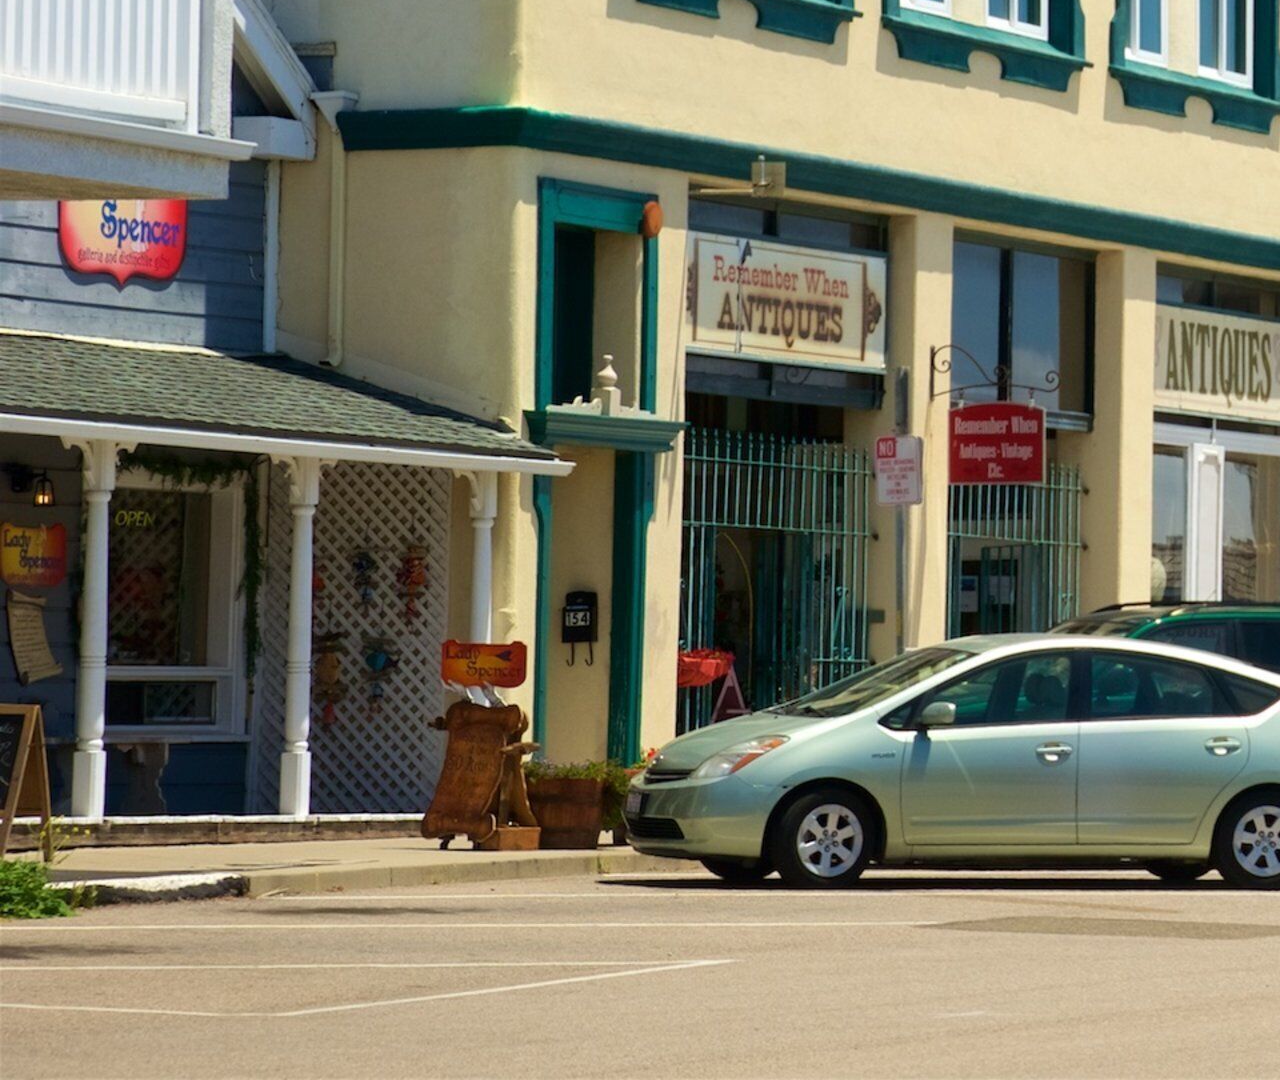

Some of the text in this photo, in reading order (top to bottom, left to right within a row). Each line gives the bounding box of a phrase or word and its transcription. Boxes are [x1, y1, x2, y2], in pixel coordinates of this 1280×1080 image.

[100, 199, 179, 248] Spencer
[712, 254, 849, 299] Remember When
[717, 292, 843, 348] ANTIQUES
[1165, 319, 1272, 408] ANTIQUES
[954, 415, 1038, 434] Remember When
[878, 440, 895, 457] NO
[115, 510, 156, 527] OPEN
[3, 528, 32, 553] Lady
[567, 612, 588, 625] 154
[445, 647, 480, 664] Lady
[466, 660, 521, 679] Spencer
